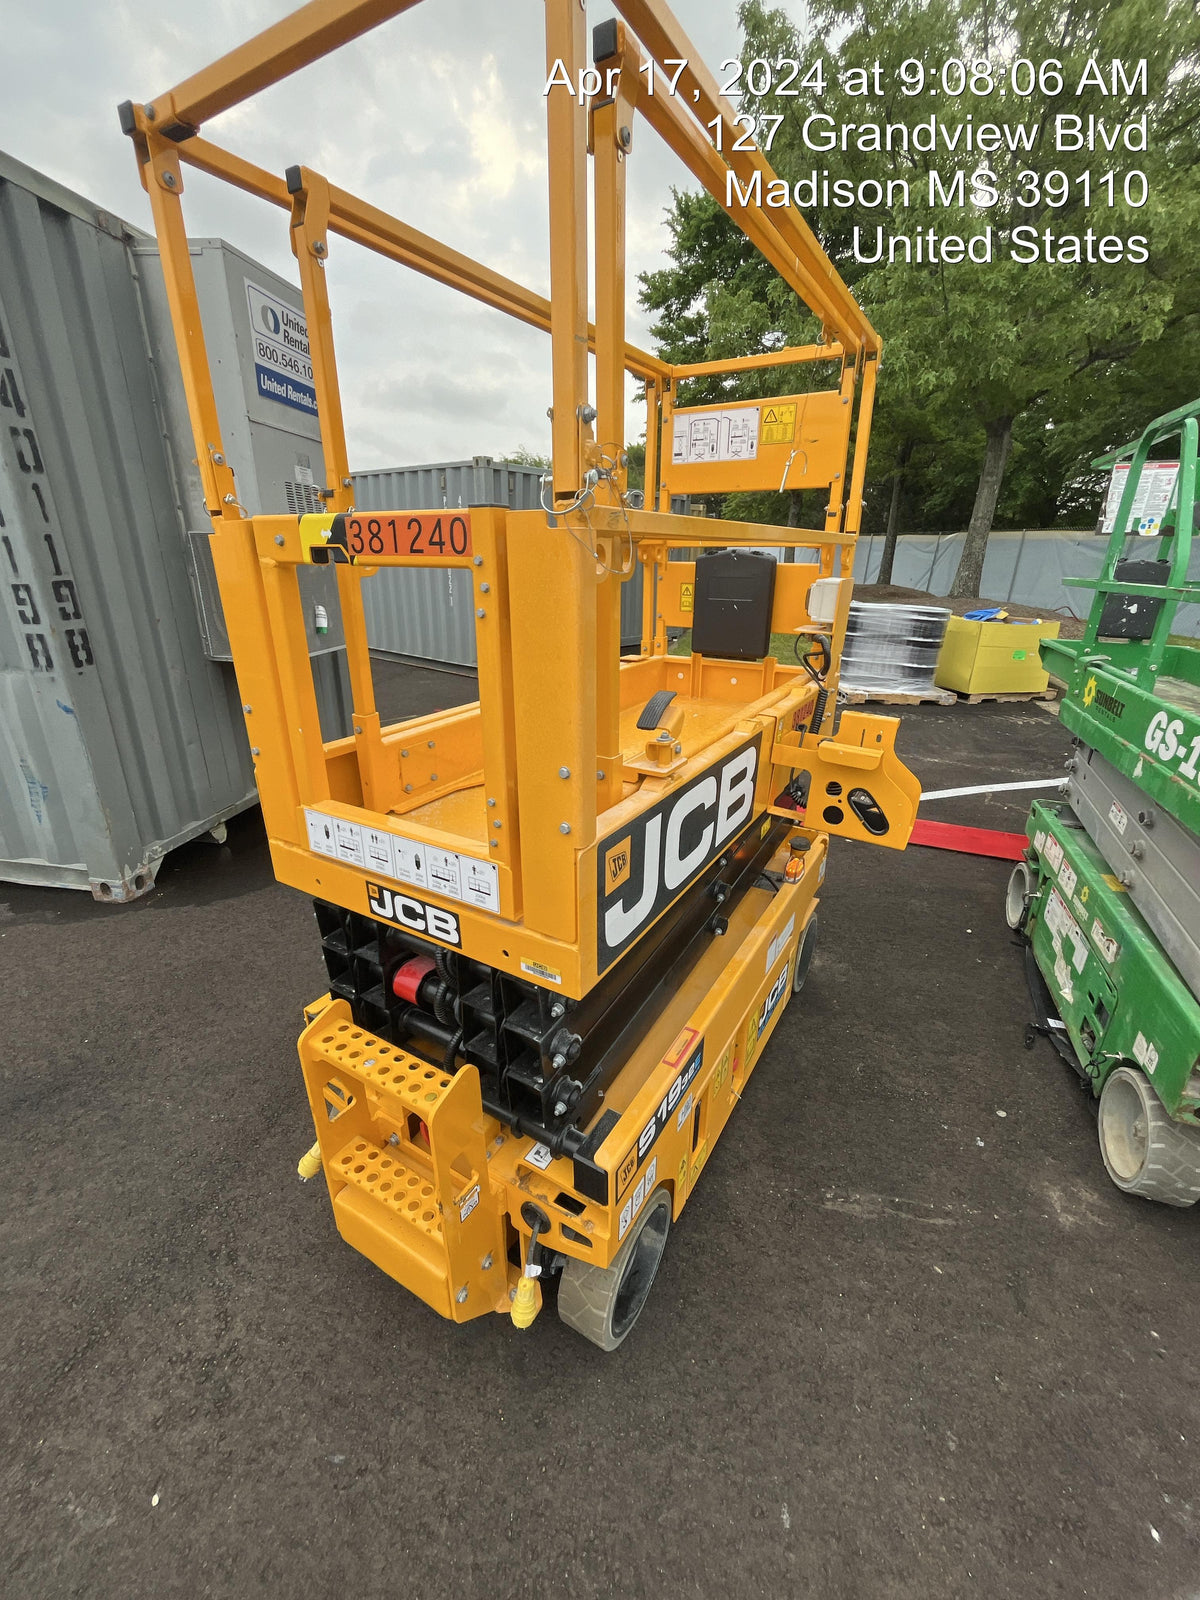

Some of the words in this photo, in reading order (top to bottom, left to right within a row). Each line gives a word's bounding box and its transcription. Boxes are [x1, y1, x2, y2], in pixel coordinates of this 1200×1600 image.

[260, 373, 287, 397] United
[349, 516, 468, 555] 381240
[1095, 688, 1126, 718] SUNBELT
[1145, 711, 1200, 788] GS-1
[604, 746, 757, 948] JCB
[610, 851, 628, 881] JCB
[370, 887, 460, 945] JCB
[759, 961, 789, 1027] JCB
[622, 1156, 635, 1182] JCB
